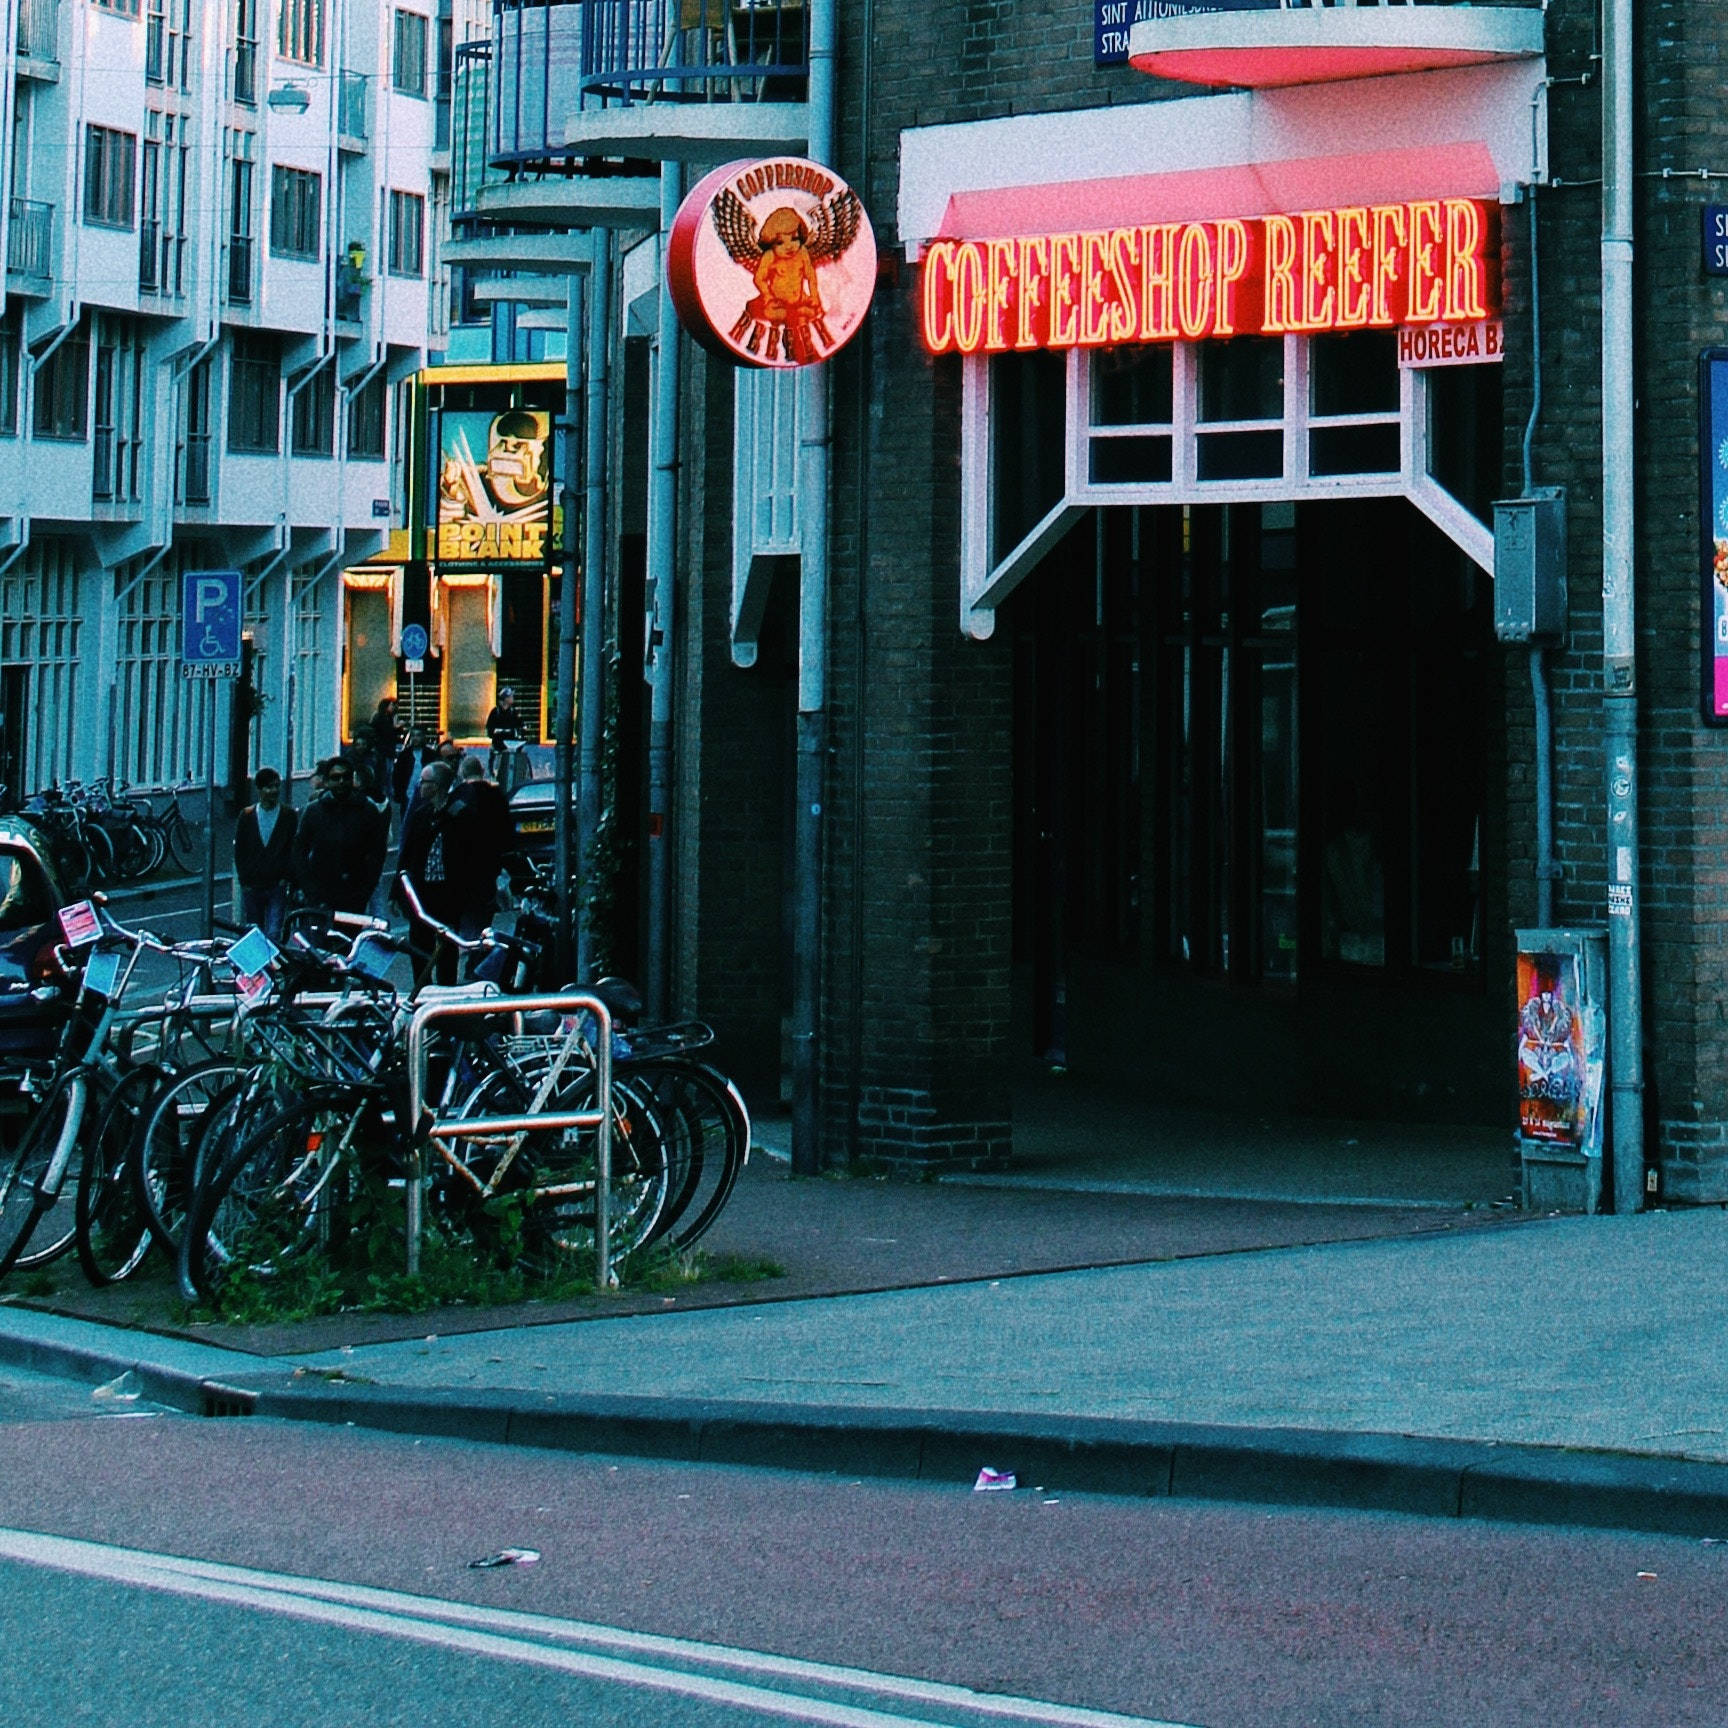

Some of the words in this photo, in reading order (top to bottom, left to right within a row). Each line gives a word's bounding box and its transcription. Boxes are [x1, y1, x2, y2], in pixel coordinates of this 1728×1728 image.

[1101, 1, 1128, 25] SINT
[736, 162, 834, 202] COFFEESHOP
[924, 217, 1248, 352] COFFEESHOP
[1261, 197, 1487, 332] REEFER
[728, 310, 836, 362] REEFER
[1401, 327, 1480, 361] HORECA
[439, 522, 549, 541] POINT
[439, 540, 545, 558] BLANK
[196, 578, 228, 624] P
